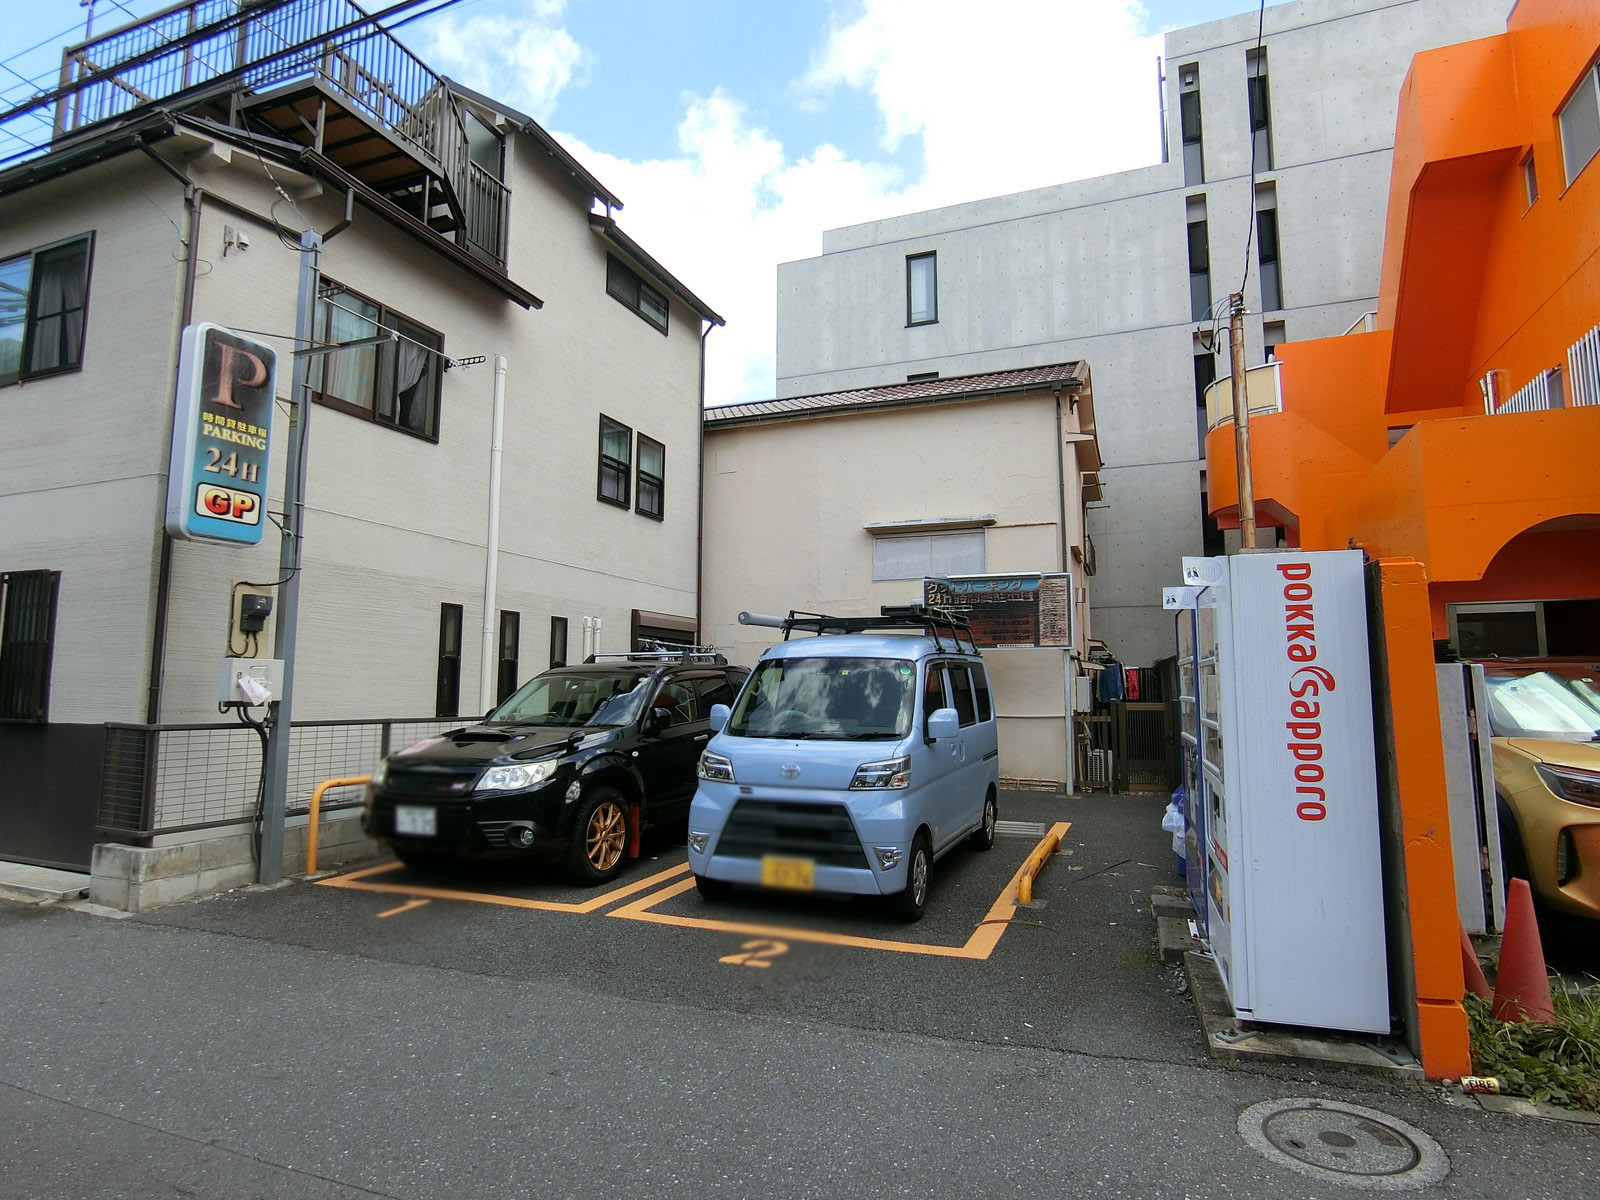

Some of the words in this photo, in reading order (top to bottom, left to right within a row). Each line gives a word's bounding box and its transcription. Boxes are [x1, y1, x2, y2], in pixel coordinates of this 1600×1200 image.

[212, 340, 269, 411] P
[202, 411, 268, 438] 時間貸駐車場
[202, 423, 267, 451] PARKING
[204, 488, 256, 518] GP
[719, 939, 789, 968] 2
[1468, 1079, 1494, 1089] FIRE
